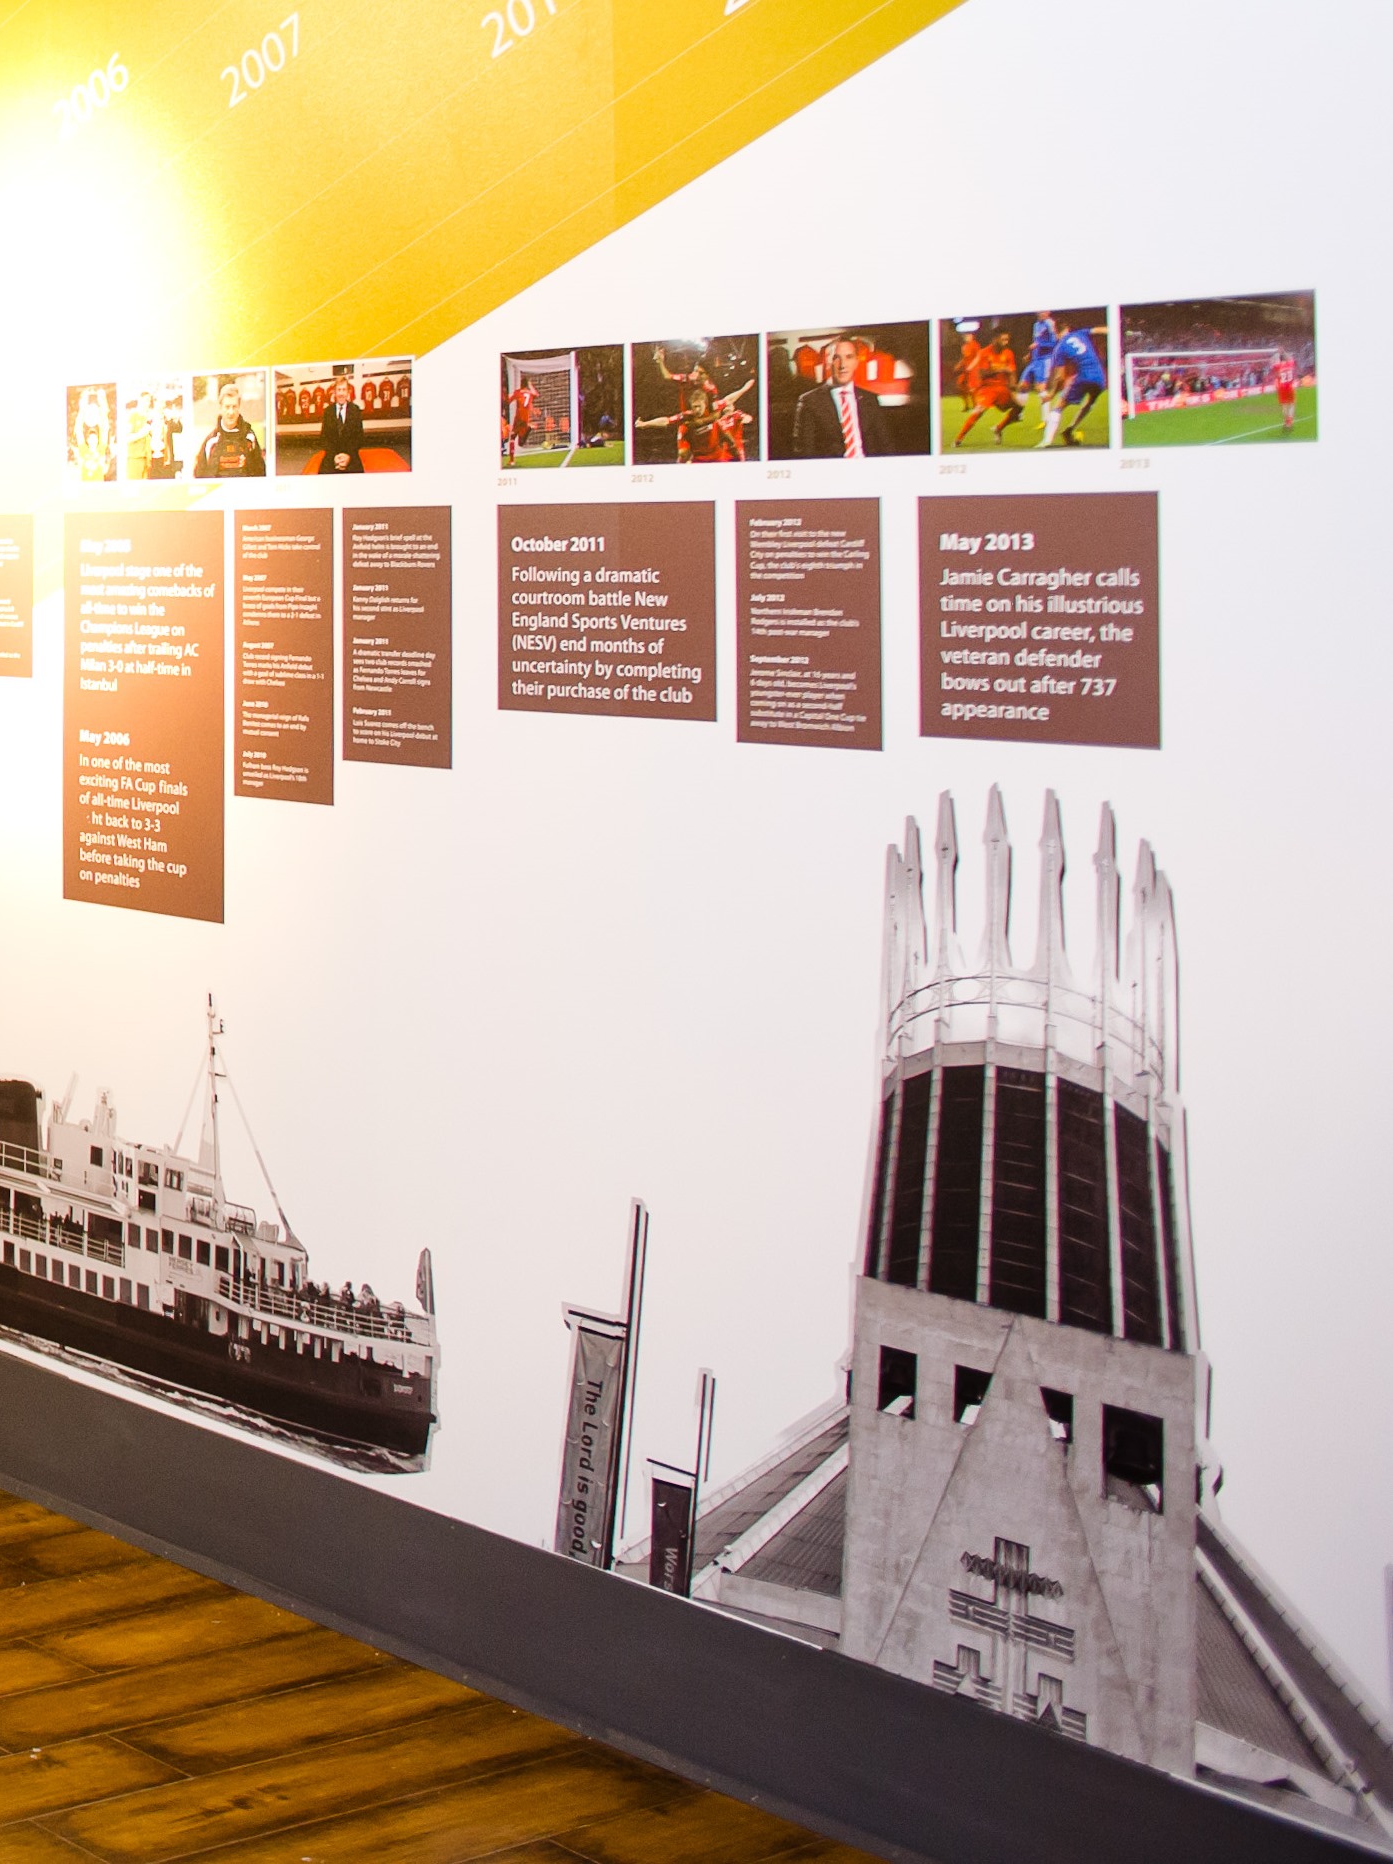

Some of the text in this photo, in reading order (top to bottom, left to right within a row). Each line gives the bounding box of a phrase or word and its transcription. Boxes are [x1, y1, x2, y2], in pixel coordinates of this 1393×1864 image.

[219, 12, 299, 108] 2007
[52, 52, 129, 142] 2006
[1066, 336, 1087, 356] 3
[511, 536, 605, 552] October 2011
[939, 532, 1035, 555] May 2013
[512, 566, 660, 586] Following a dramatic
[939, 567, 1140, 590] Jamie Carragher calls
[512, 590, 669, 607] courtroom battle New
[940, 594, 1144, 615] time on his illustrious
[512, 611, 687, 632] England Sports Ventures
[941, 620, 1134, 643] Liverpool career, the
[512, 634, 665, 654] (NESV) end months of
[940, 648, 1102, 668] veteran defender
[512, 659, 702, 684] uncertainty by completing
[512, 679, 693, 703] their purchase of the club
[941, 672, 1117, 696] bows out after 737
[941, 703, 1050, 721] appearance
[79, 729, 130, 747] May 2006
[79, 754, 170, 775] In one of the most
[79, 774, 188, 796] exciting FA Cup finals
[79, 791, 180, 816] of all-time Liverpool
[79, 870, 140, 888] on penalties
[584, 1380, 603, 1416] The
[579, 1420, 599, 1474] Lord
[576, 1475, 594, 1495] is
